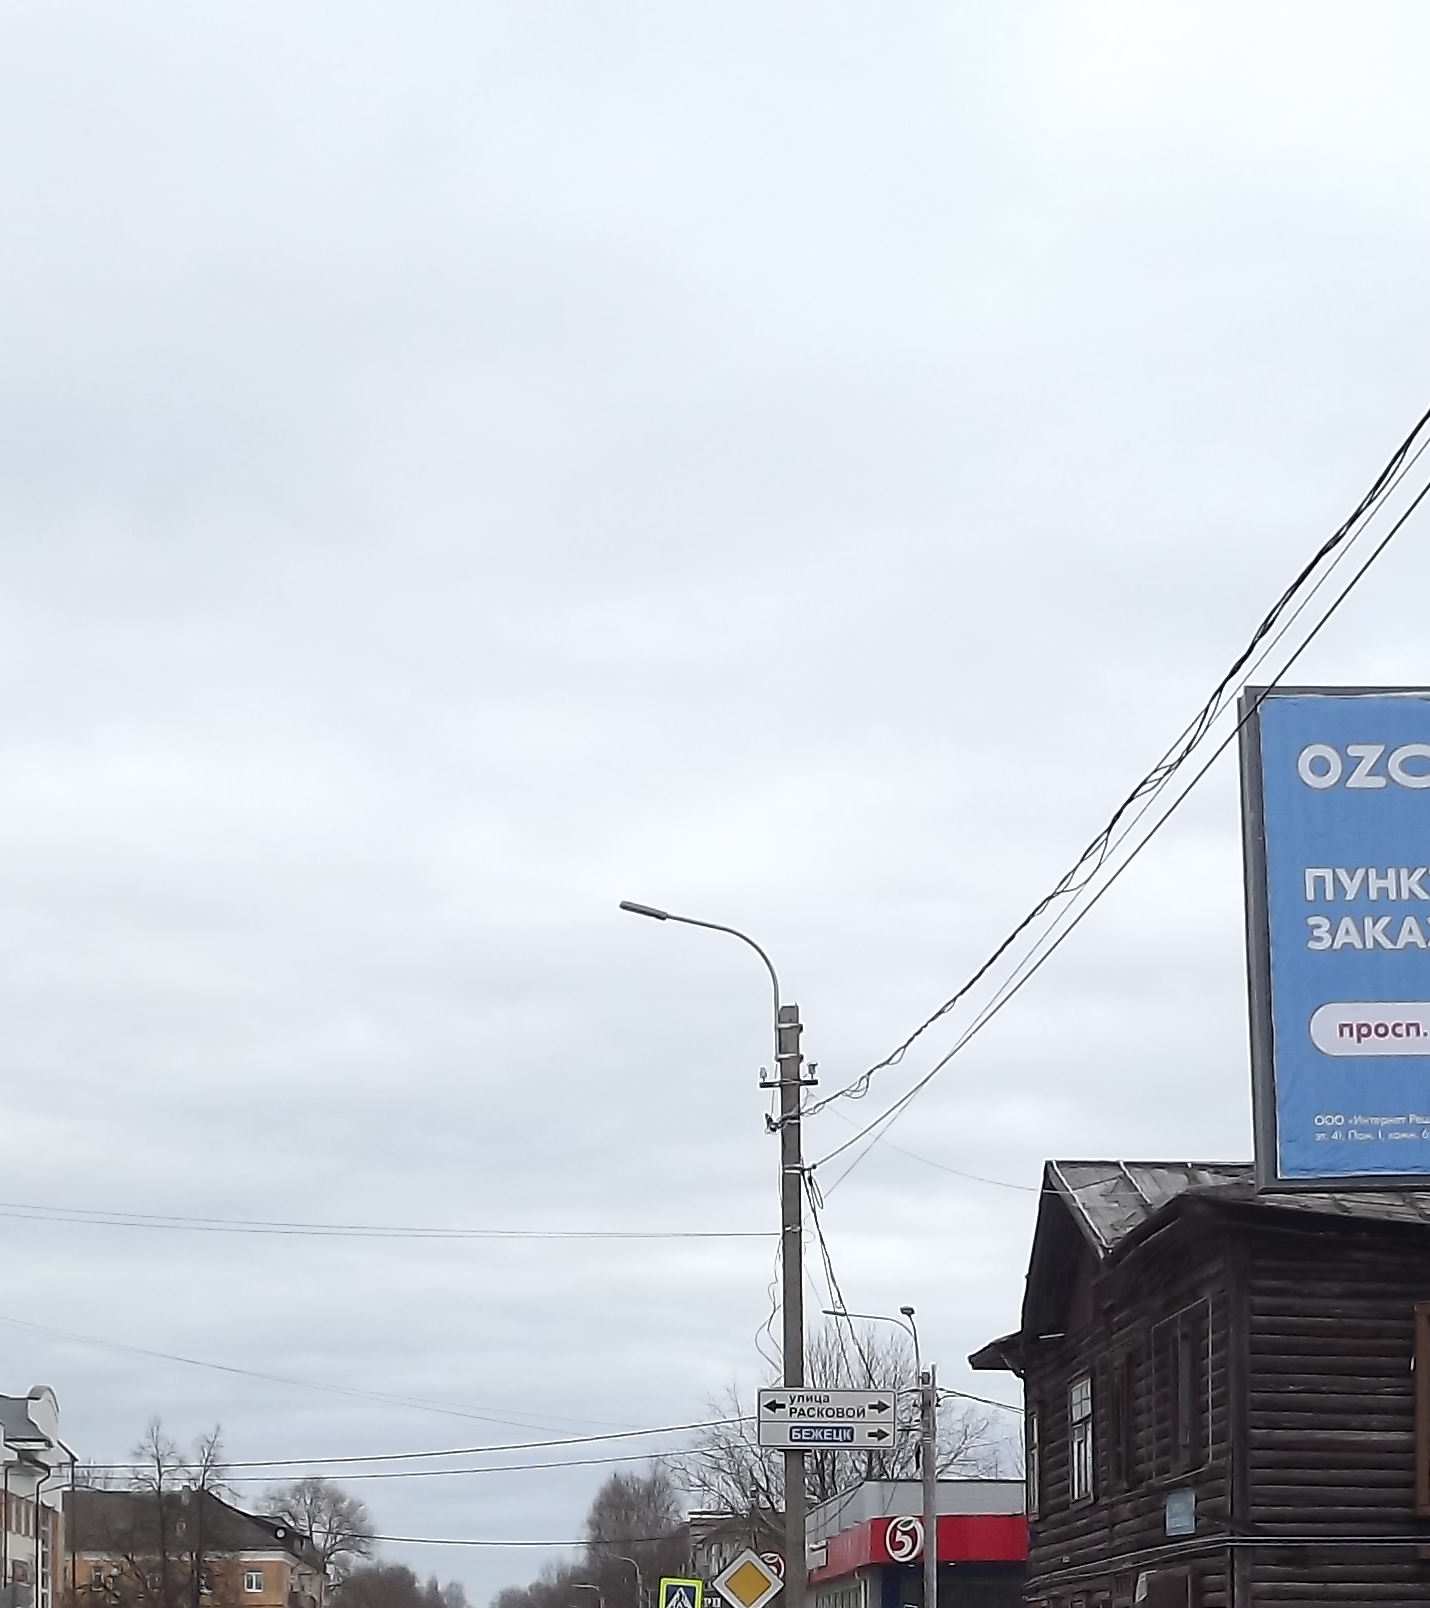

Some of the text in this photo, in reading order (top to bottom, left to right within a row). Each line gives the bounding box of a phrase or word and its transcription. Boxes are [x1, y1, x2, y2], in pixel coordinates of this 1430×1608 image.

[1337, 1020, 1428, 1044] просп.
[1314, 1114, 1345, 1126] ООО
[789, 1394, 830, 1405] улица
[789, 1405, 866, 1418] РАСКОВОЙ
[791, 1428, 852, 1441] БЕЖЕЦК
